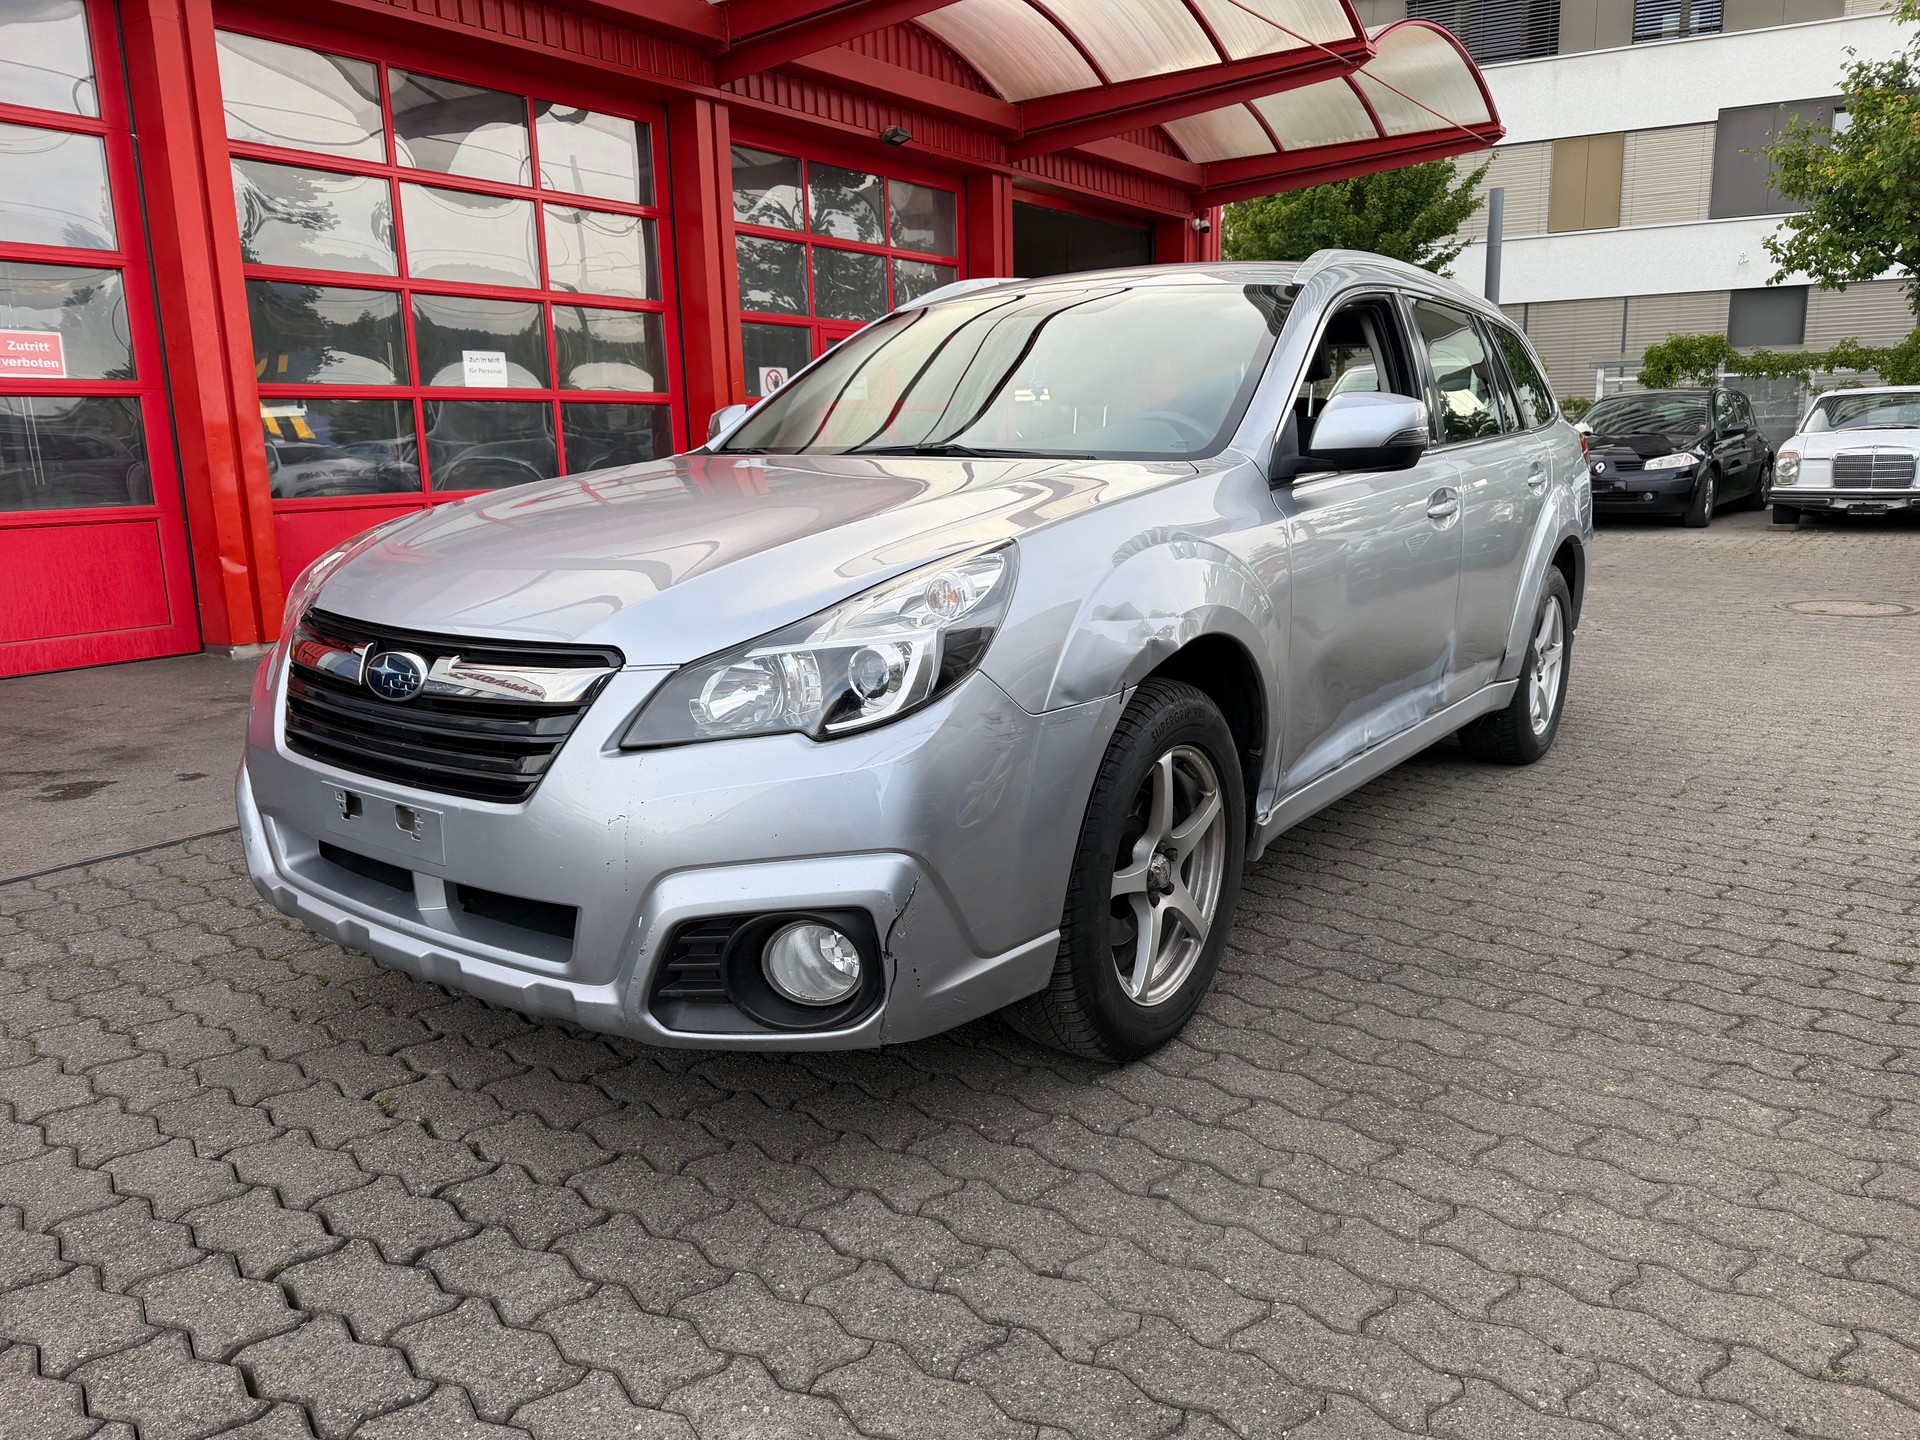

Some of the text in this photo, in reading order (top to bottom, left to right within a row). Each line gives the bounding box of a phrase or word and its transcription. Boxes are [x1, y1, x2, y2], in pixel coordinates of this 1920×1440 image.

[7, 340, 50, 352] Zutritt
[1, 357, 60, 368] verboten
[469, 356, 487, 364] Zutritt
[1150, 707, 1192, 744] SUPERGRIP
